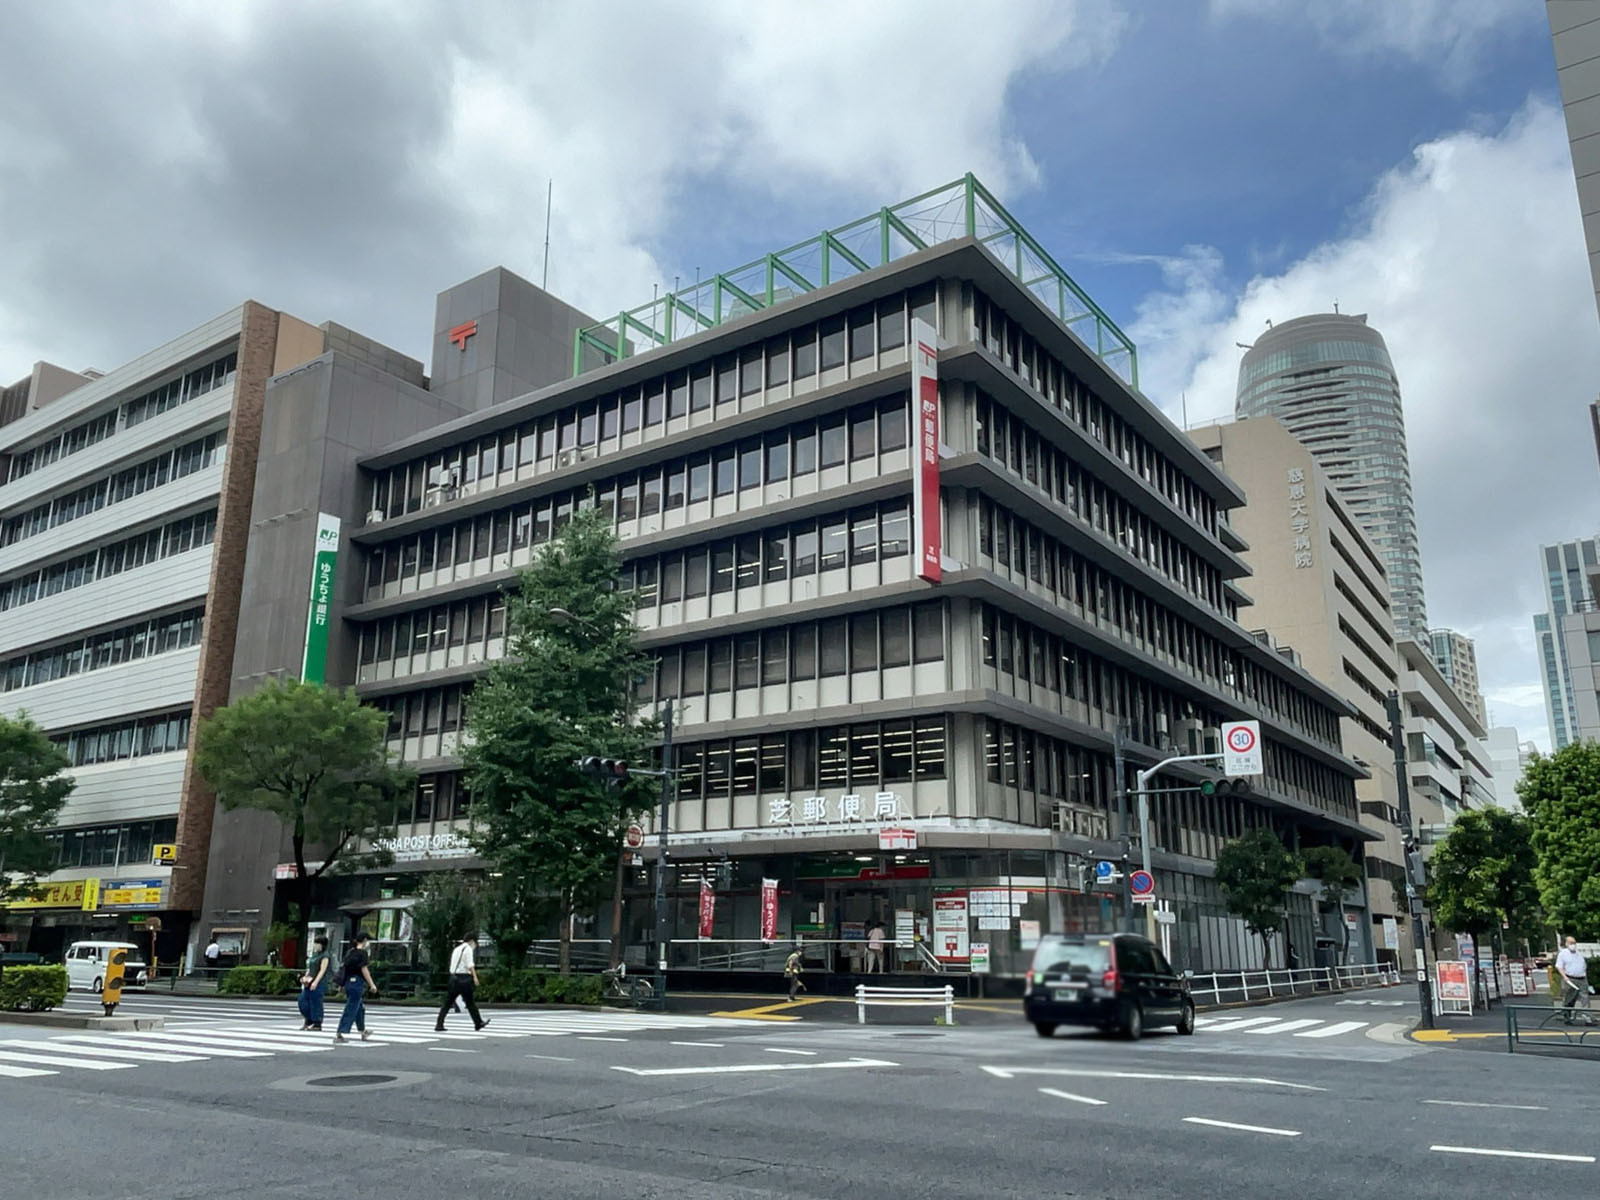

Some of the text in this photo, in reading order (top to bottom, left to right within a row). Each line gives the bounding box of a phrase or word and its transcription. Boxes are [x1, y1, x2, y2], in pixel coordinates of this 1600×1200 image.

[316, 562, 331, 626] ゆうちょ銀行
[1234, 733, 1249, 746] 30
[768, 791, 897, 823] 芝郵便局
[403, 834, 432, 849] POST
[160, 847, 171, 858] P
